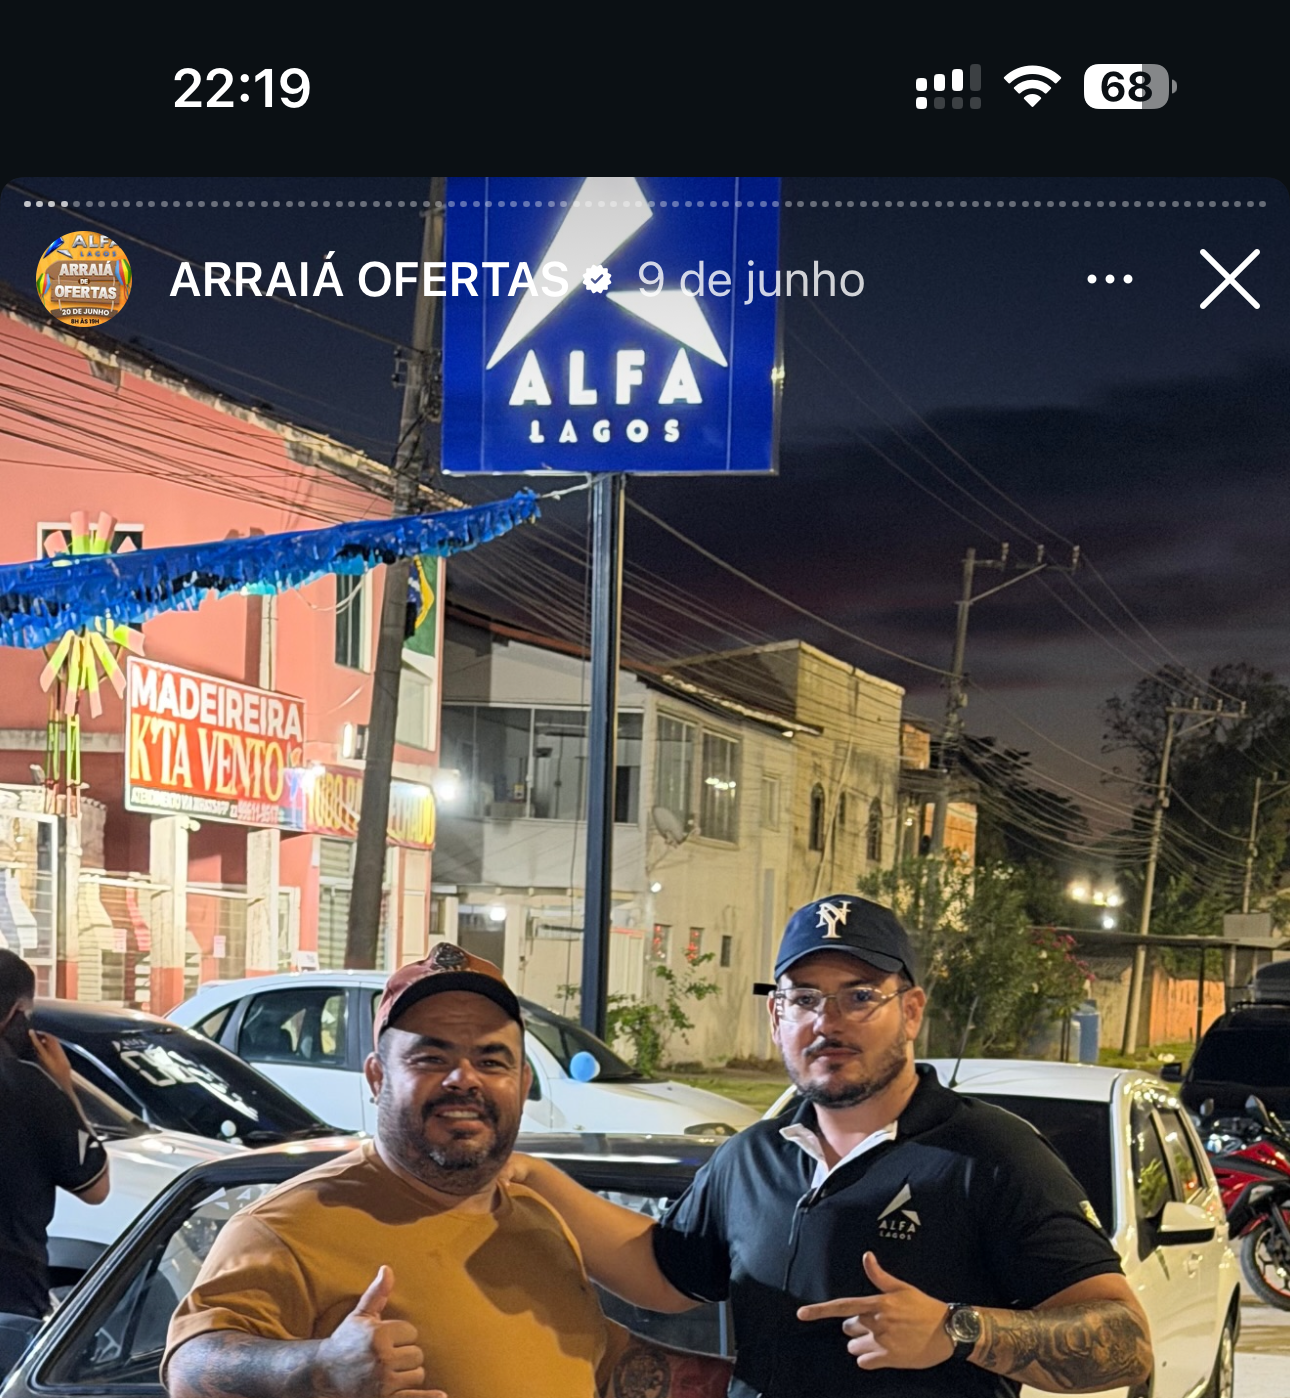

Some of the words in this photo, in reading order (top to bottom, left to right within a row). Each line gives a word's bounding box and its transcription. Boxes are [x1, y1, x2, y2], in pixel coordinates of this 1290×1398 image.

[509, 347, 703, 406] ALFA
[529, 419, 680, 443] LAGOS
[131, 663, 303, 743] MADEIREIRA
[197, 727, 284, 802] VENTO
[815, 900, 852, 939] NY
[878, 1219, 916, 1232] ALFA
